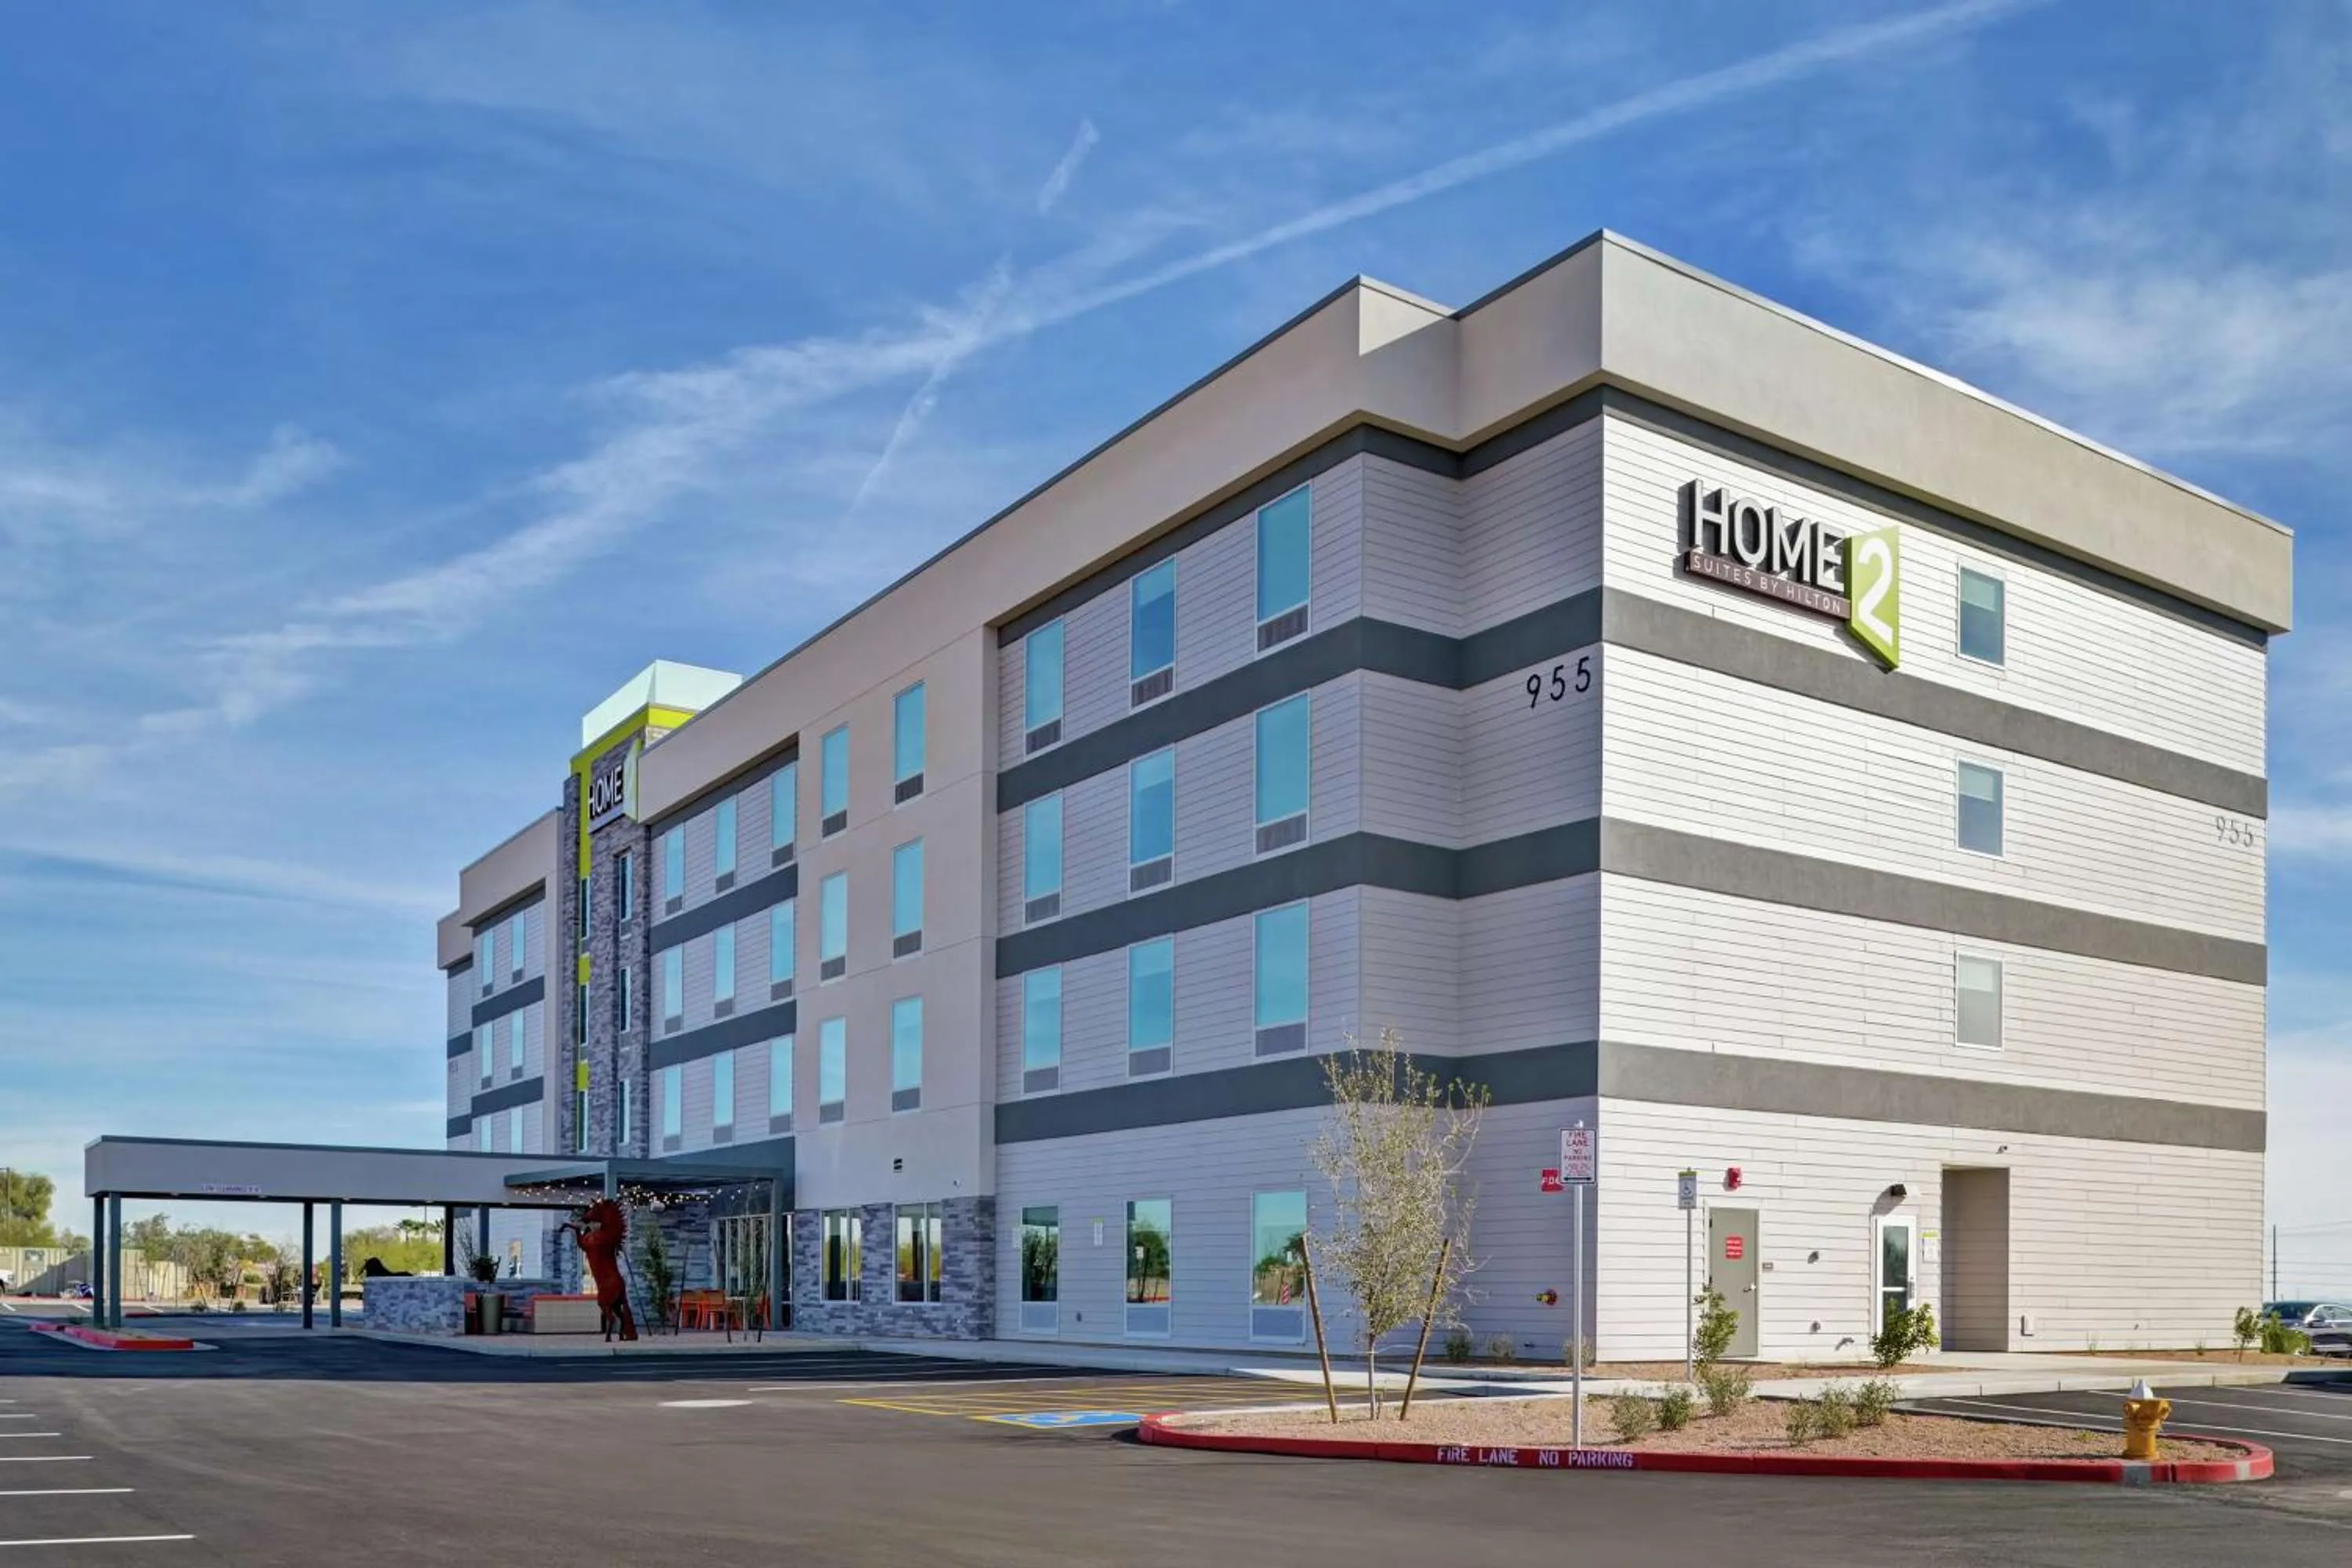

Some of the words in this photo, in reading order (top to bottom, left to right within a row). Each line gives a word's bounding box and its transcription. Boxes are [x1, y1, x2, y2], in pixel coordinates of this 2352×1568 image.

[1693, 478, 1846, 592] HOME
[1857, 537, 1893, 648] 2
[1693, 555, 1751, 586] SUITES
[1760, 576, 1780, 593] BY
[1787, 585, 1842, 614] HILTON
[1526, 655, 1591, 709] 955
[588, 764, 622, 817] HOME
[2216, 815, 2254, 848] 955
[1437, 1447, 1470, 1462] FIRE
[1479, 1448, 1518, 1465] LANE
[1538, 1450, 1559, 1465] NO
[1569, 1451, 1633, 1468] PARKING
